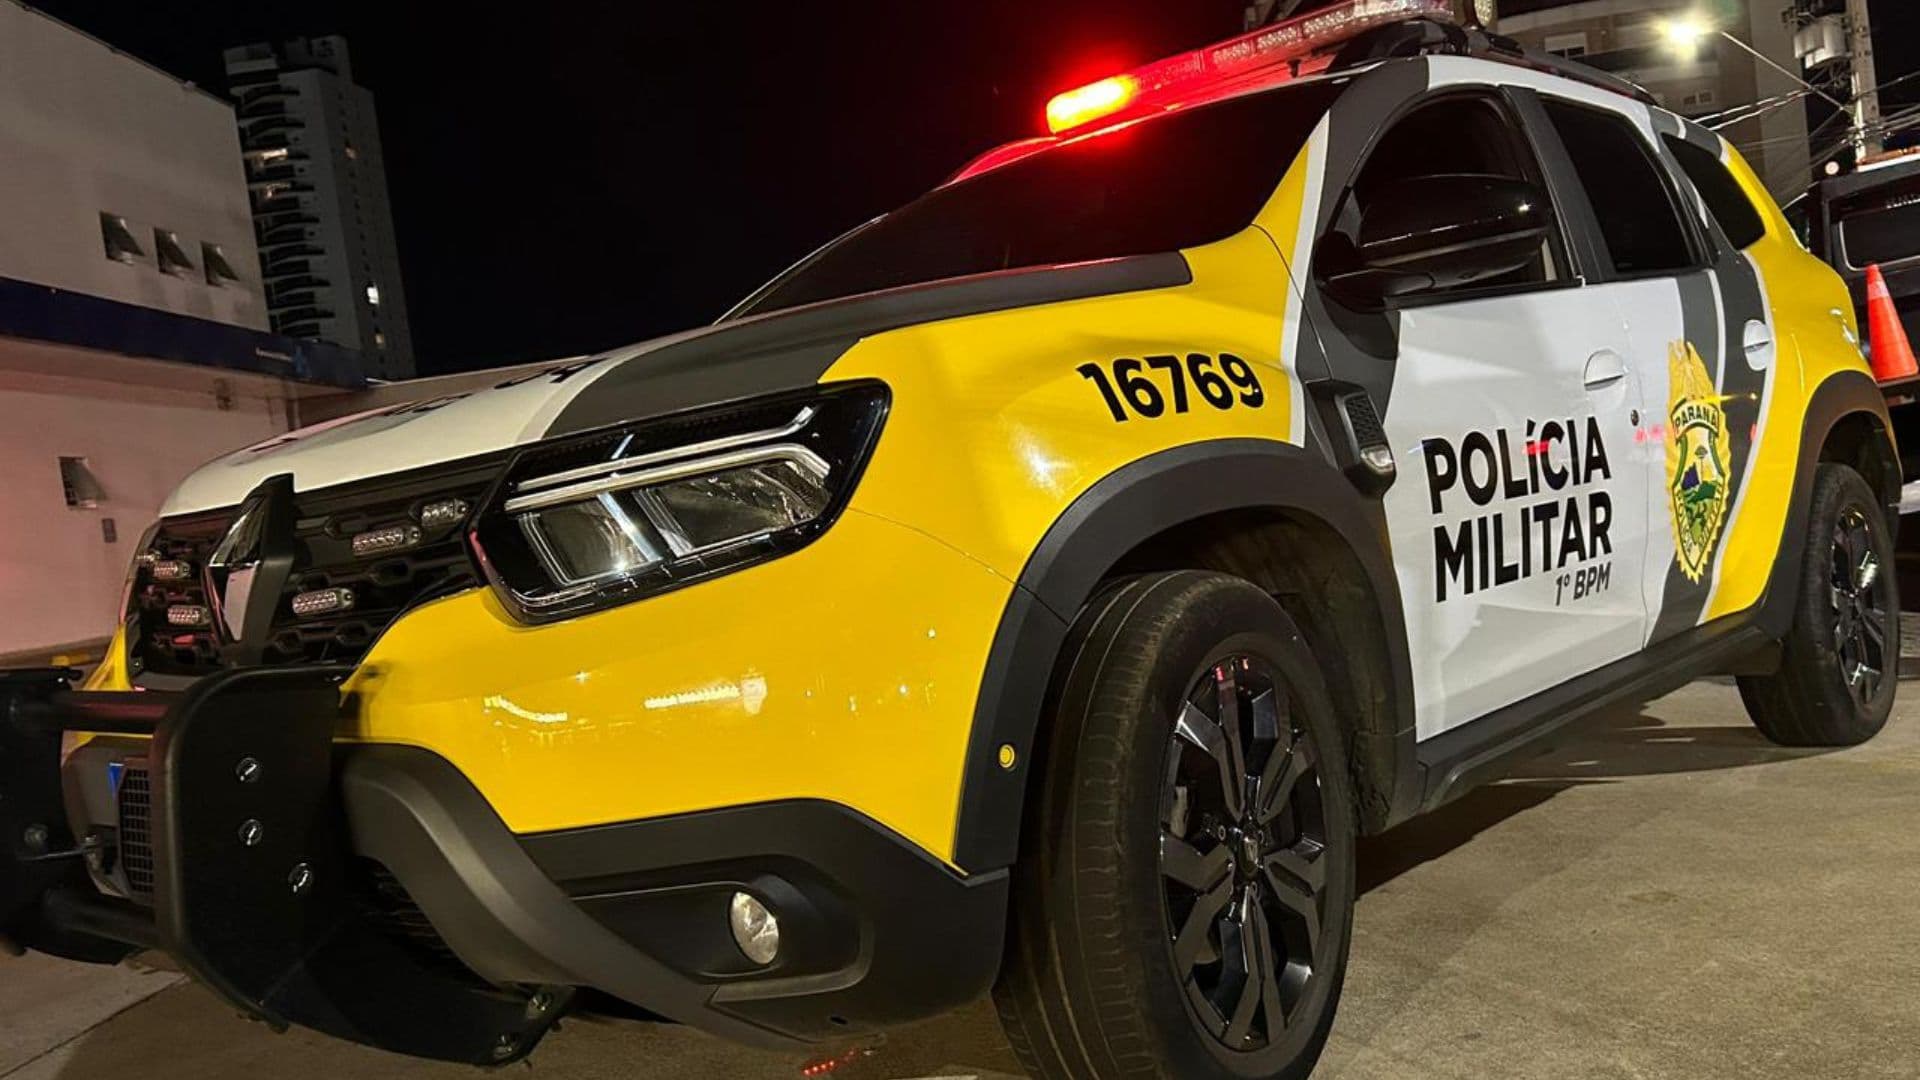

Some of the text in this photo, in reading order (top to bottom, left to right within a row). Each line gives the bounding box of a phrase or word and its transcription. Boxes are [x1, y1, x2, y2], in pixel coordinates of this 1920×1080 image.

[1076, 353, 1264, 423] 16769
[1421, 416, 1612, 515] POLÍCIA
[1433, 491, 1612, 603] MILITAR
[1573, 560, 1612, 600] BPM
